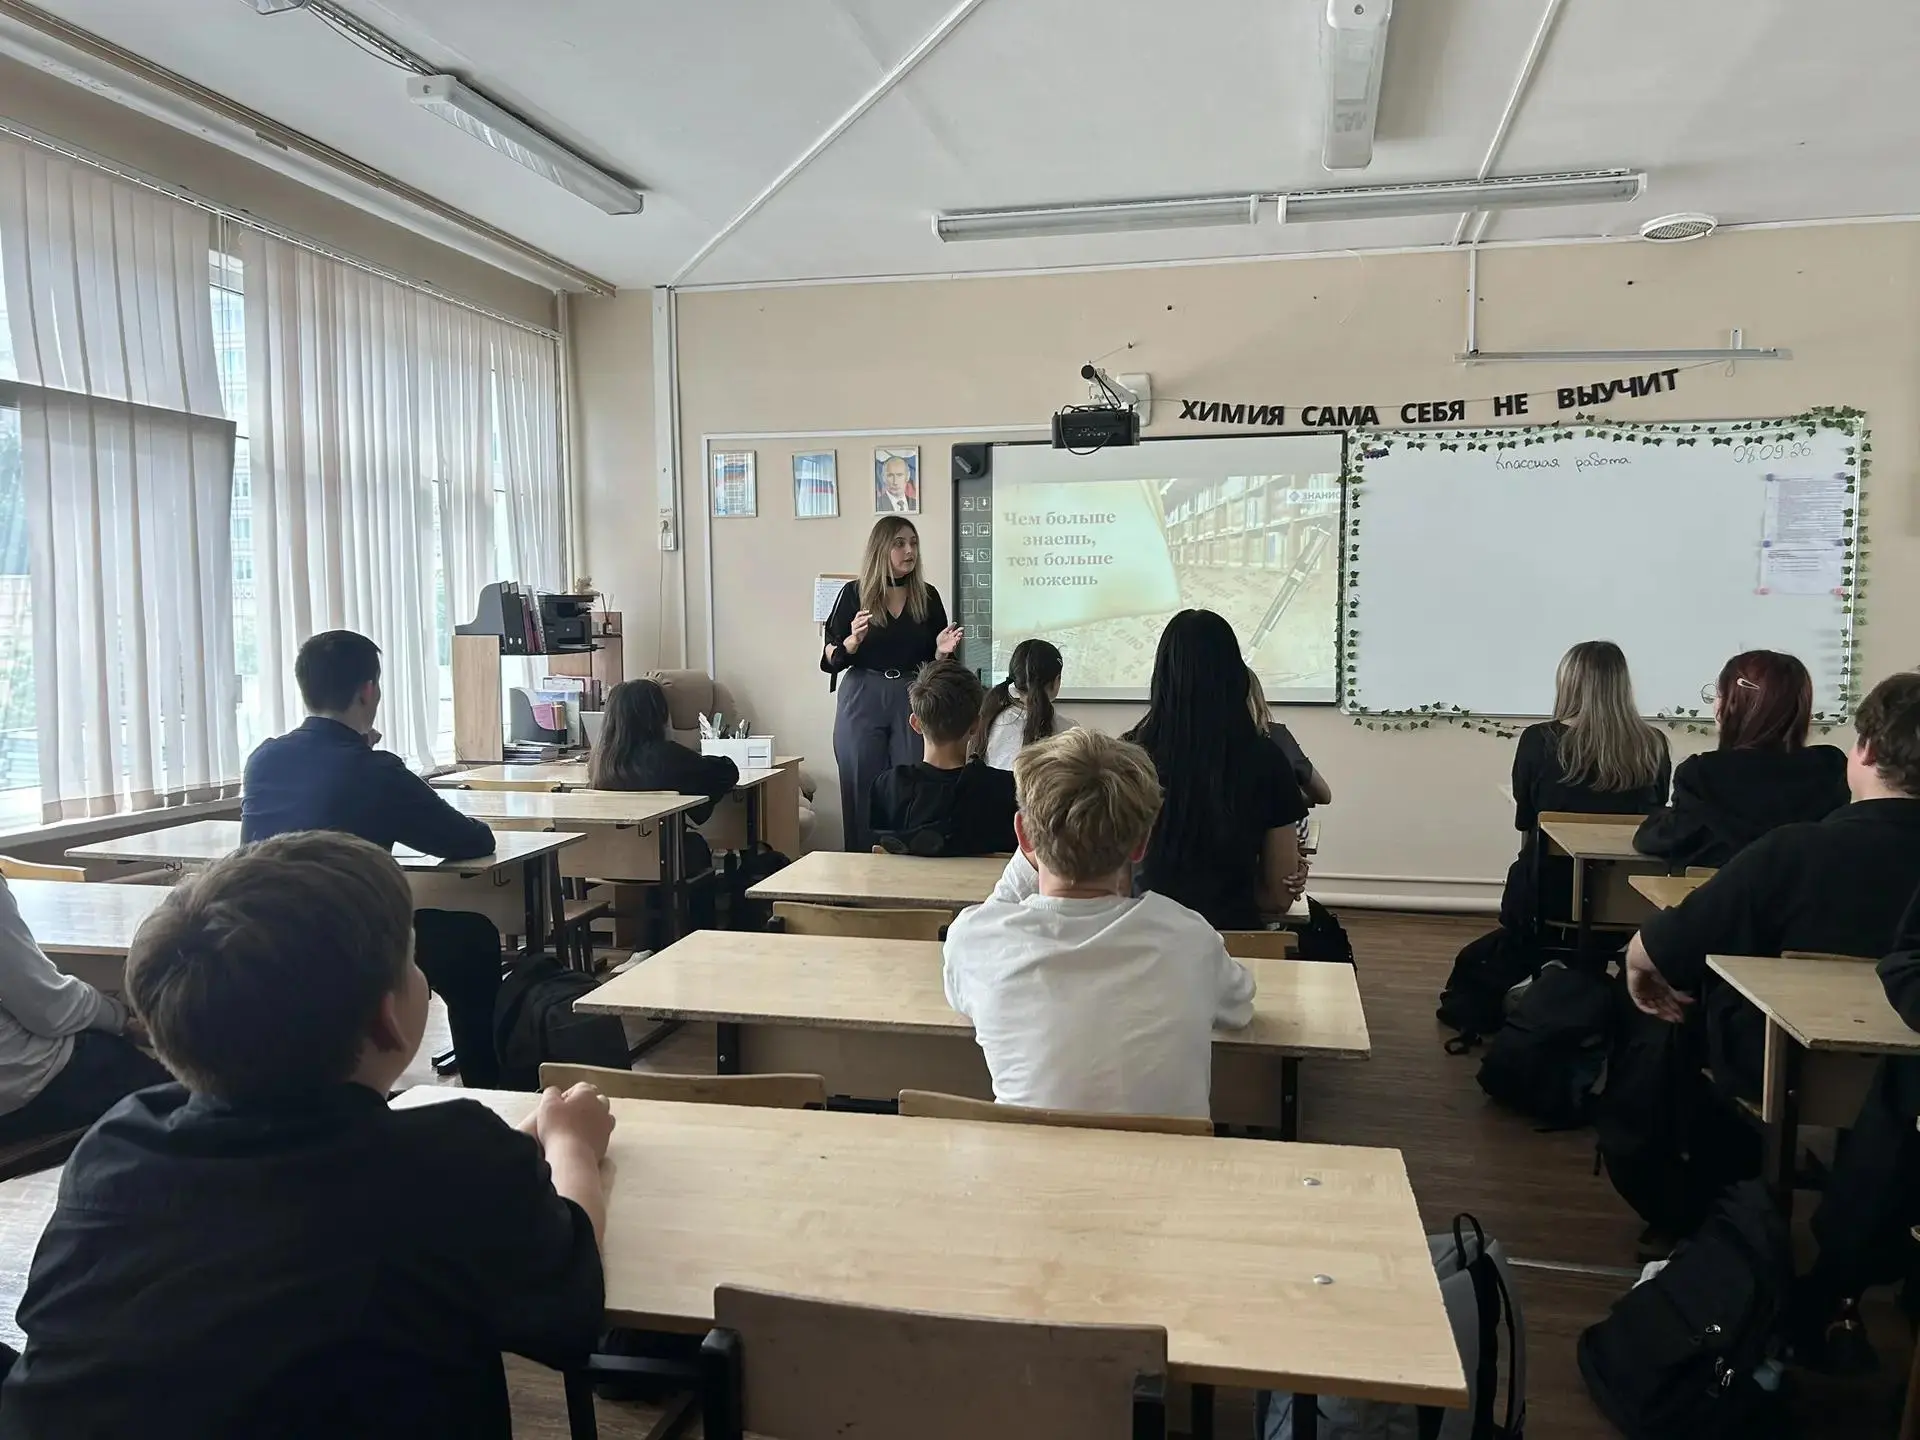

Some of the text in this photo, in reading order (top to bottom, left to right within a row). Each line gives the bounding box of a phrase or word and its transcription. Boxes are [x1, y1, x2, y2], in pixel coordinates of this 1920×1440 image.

[1179, 368, 1679, 427] ХИМИЯ САМА СЕБЯ НЕ ВЫУЧИТ
[1003, 511, 1117, 525] Чем больше
[1022, 534, 1097, 547] знаешь,
[1006, 552, 1114, 567] тем больше
[1022, 575, 1098, 586] можешь
